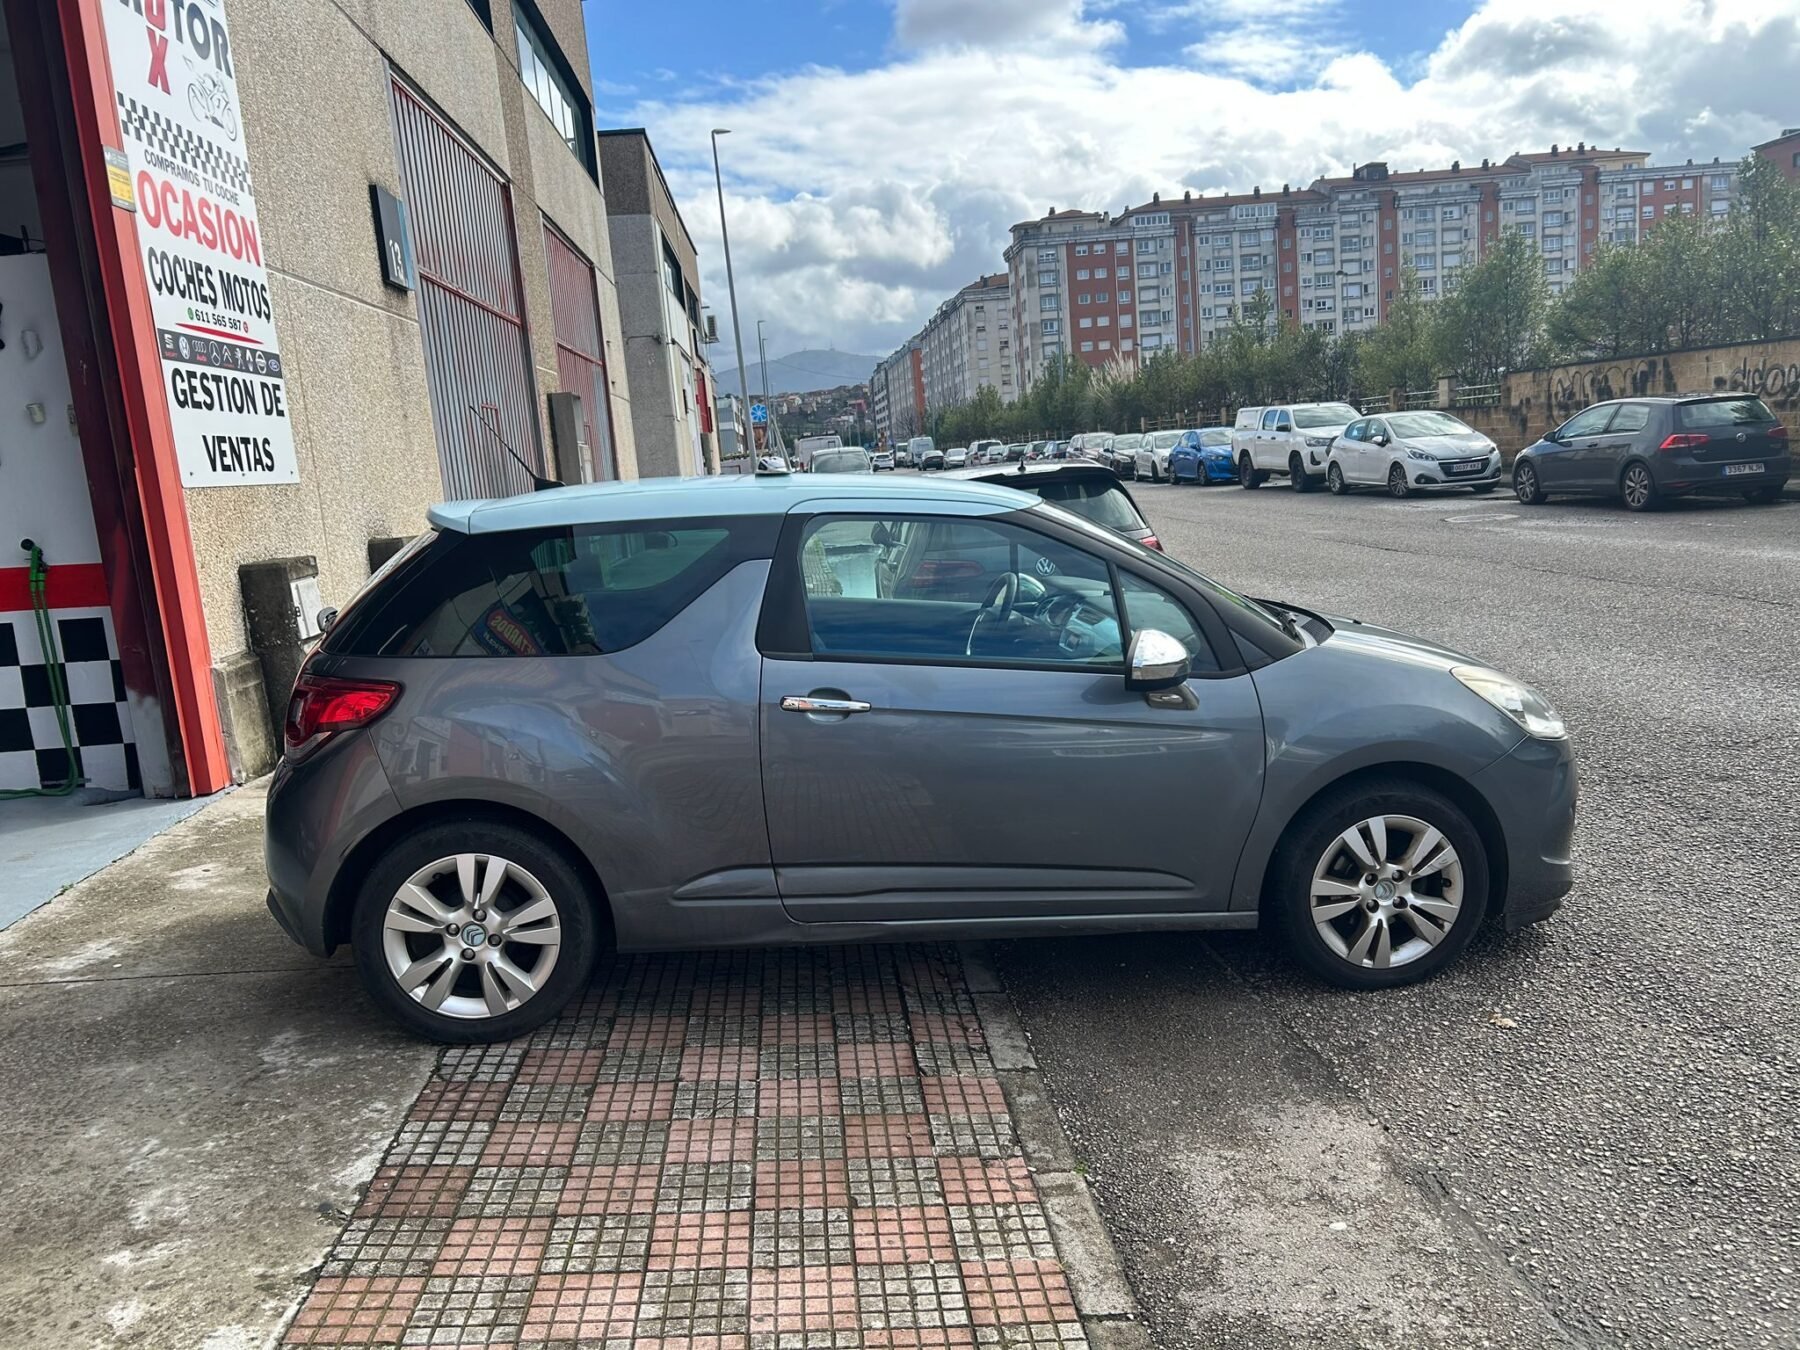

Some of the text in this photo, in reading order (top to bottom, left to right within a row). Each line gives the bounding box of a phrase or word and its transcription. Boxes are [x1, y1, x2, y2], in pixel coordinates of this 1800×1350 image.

[144, 149, 200, 187] COMPRAMOS
[203, 176, 214, 193] TU
[215, 179, 240, 206] COCHE
[136, 169, 260, 266] OCASION
[147, 246, 271, 321] COCHES MOTOS
[195, 309, 242, 332] 611 565 587
[171, 367, 285, 417] GESTION DE
[202, 434, 274, 473] VENTAS
